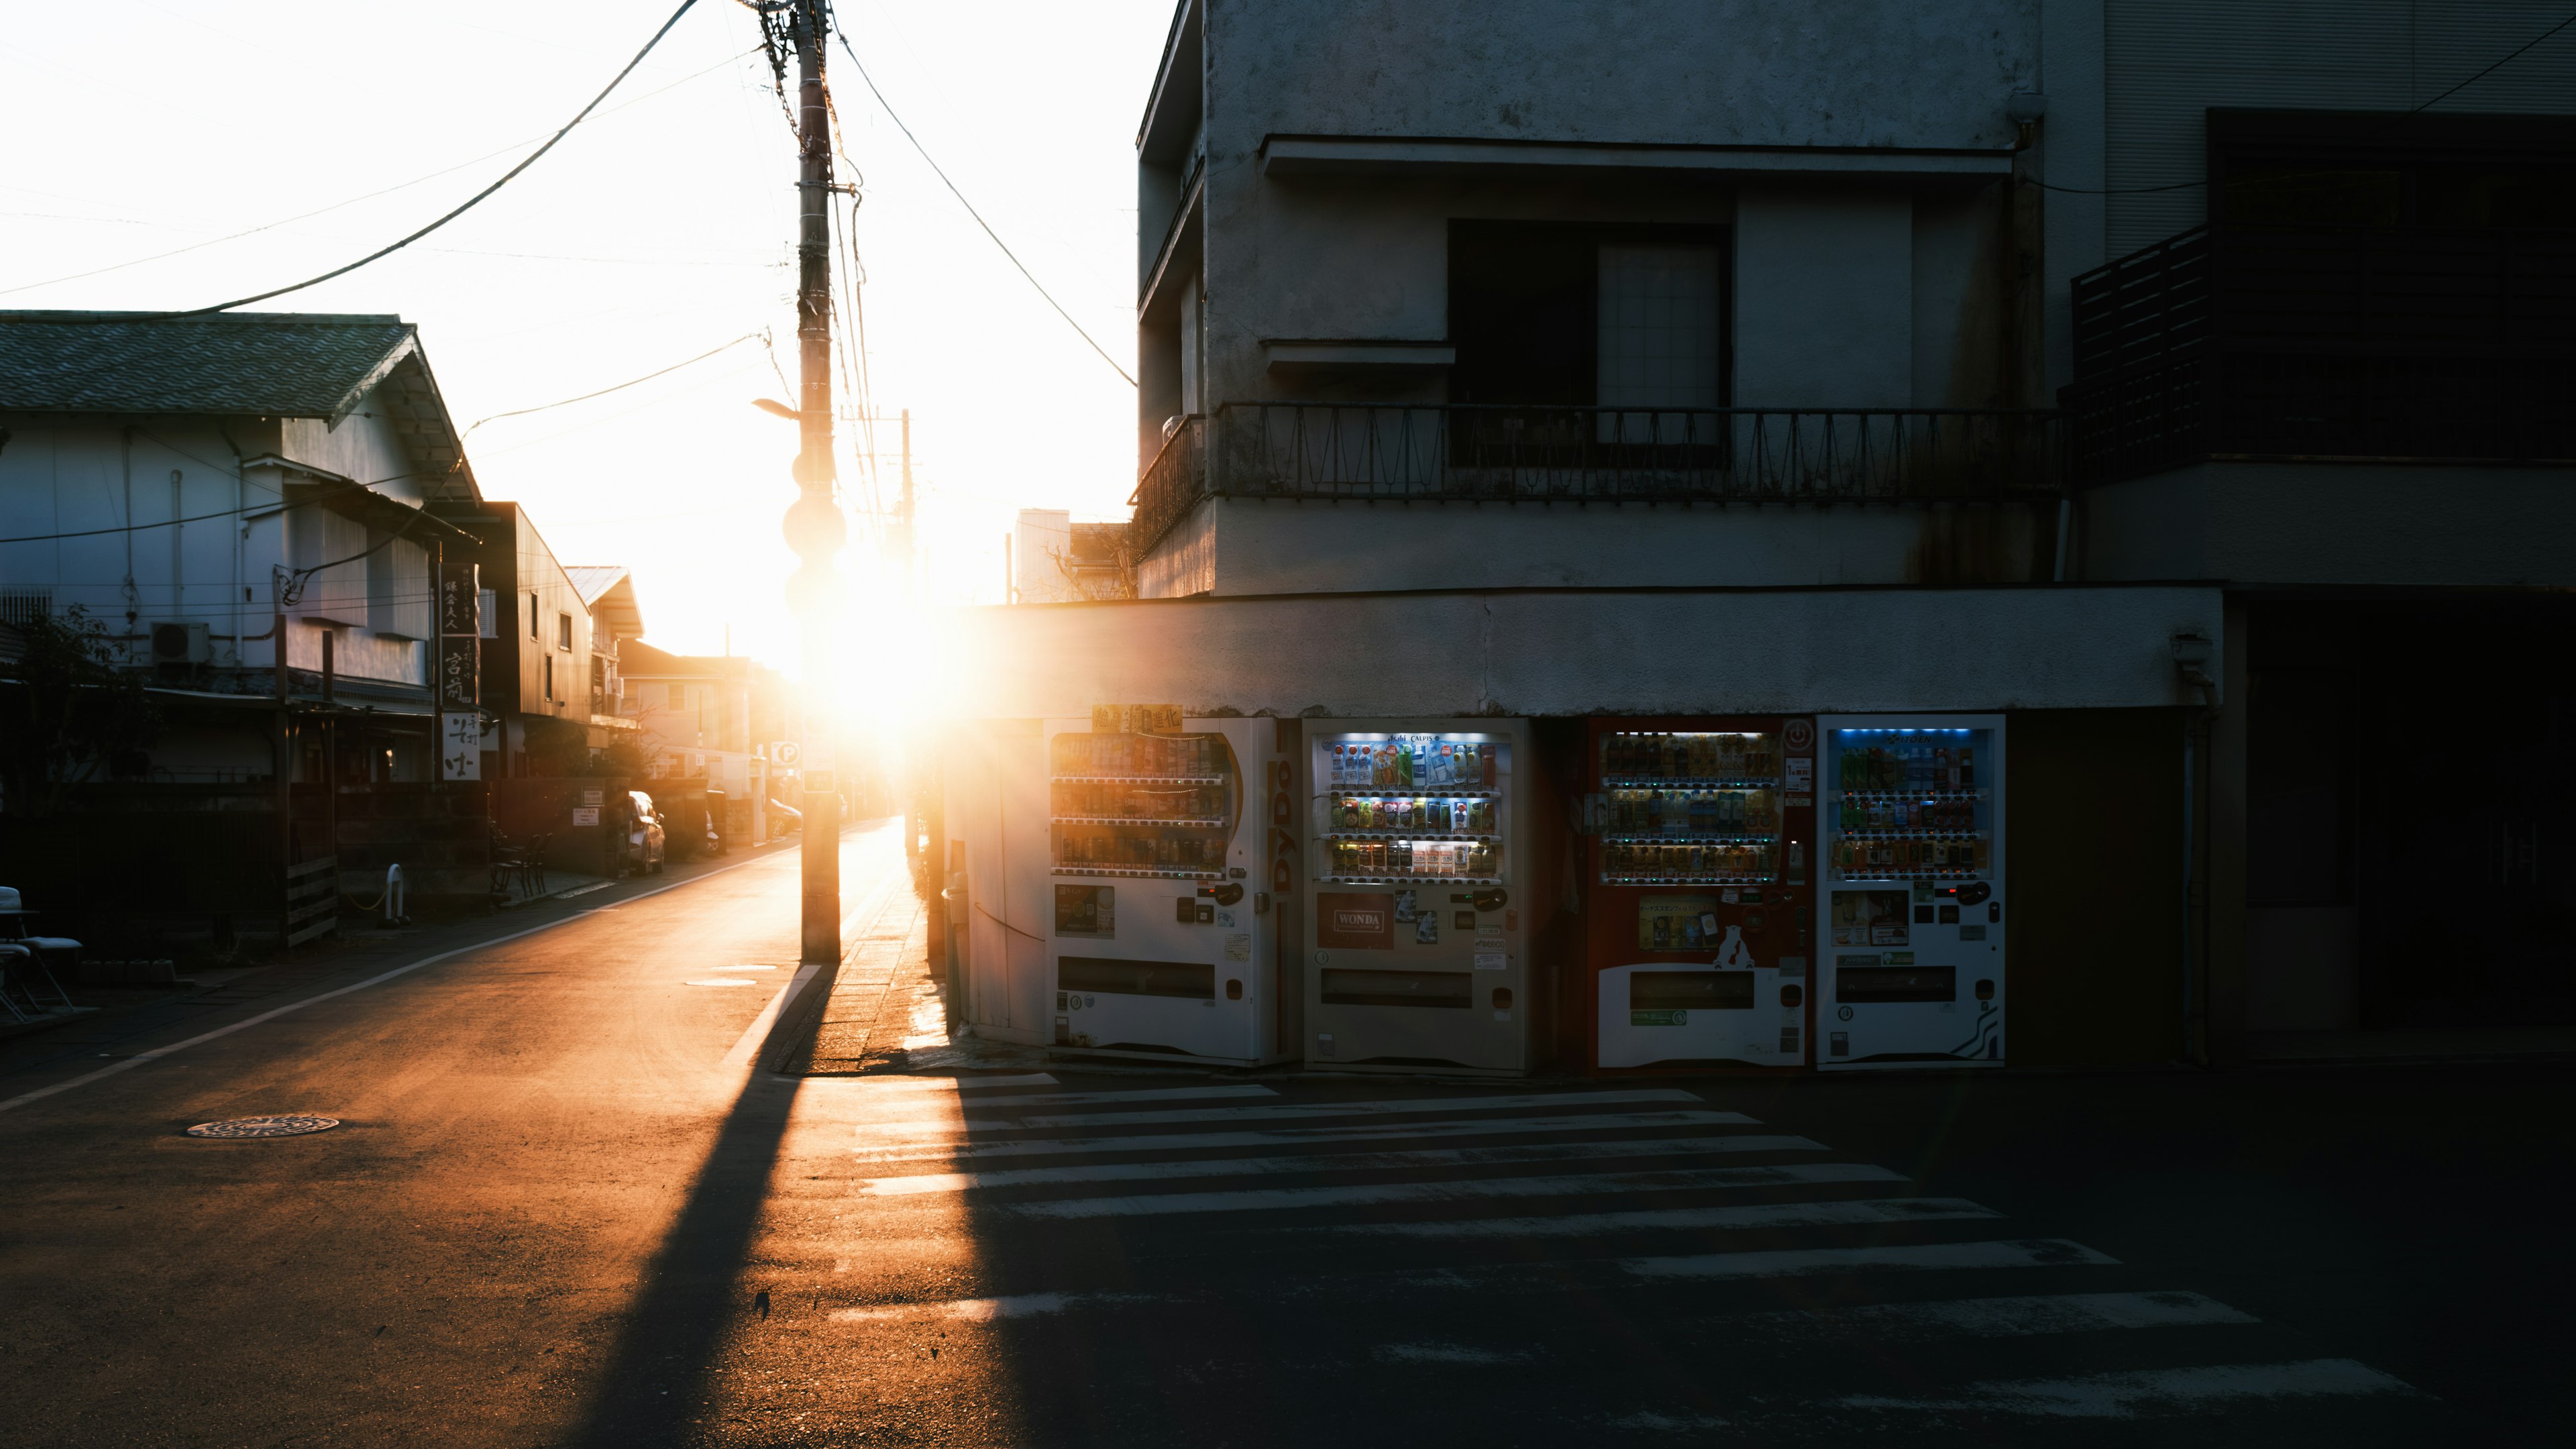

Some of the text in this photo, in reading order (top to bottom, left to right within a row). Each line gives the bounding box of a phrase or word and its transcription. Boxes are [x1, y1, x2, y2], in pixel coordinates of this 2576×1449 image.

[443, 581, 458, 629] 鎌倉夫人
[445, 651, 463, 702] 宮前
[1900, 735, 1932, 743] ITO EN
[783, 746, 795, 761] P
[1338, 913, 1380, 925] WONDA
